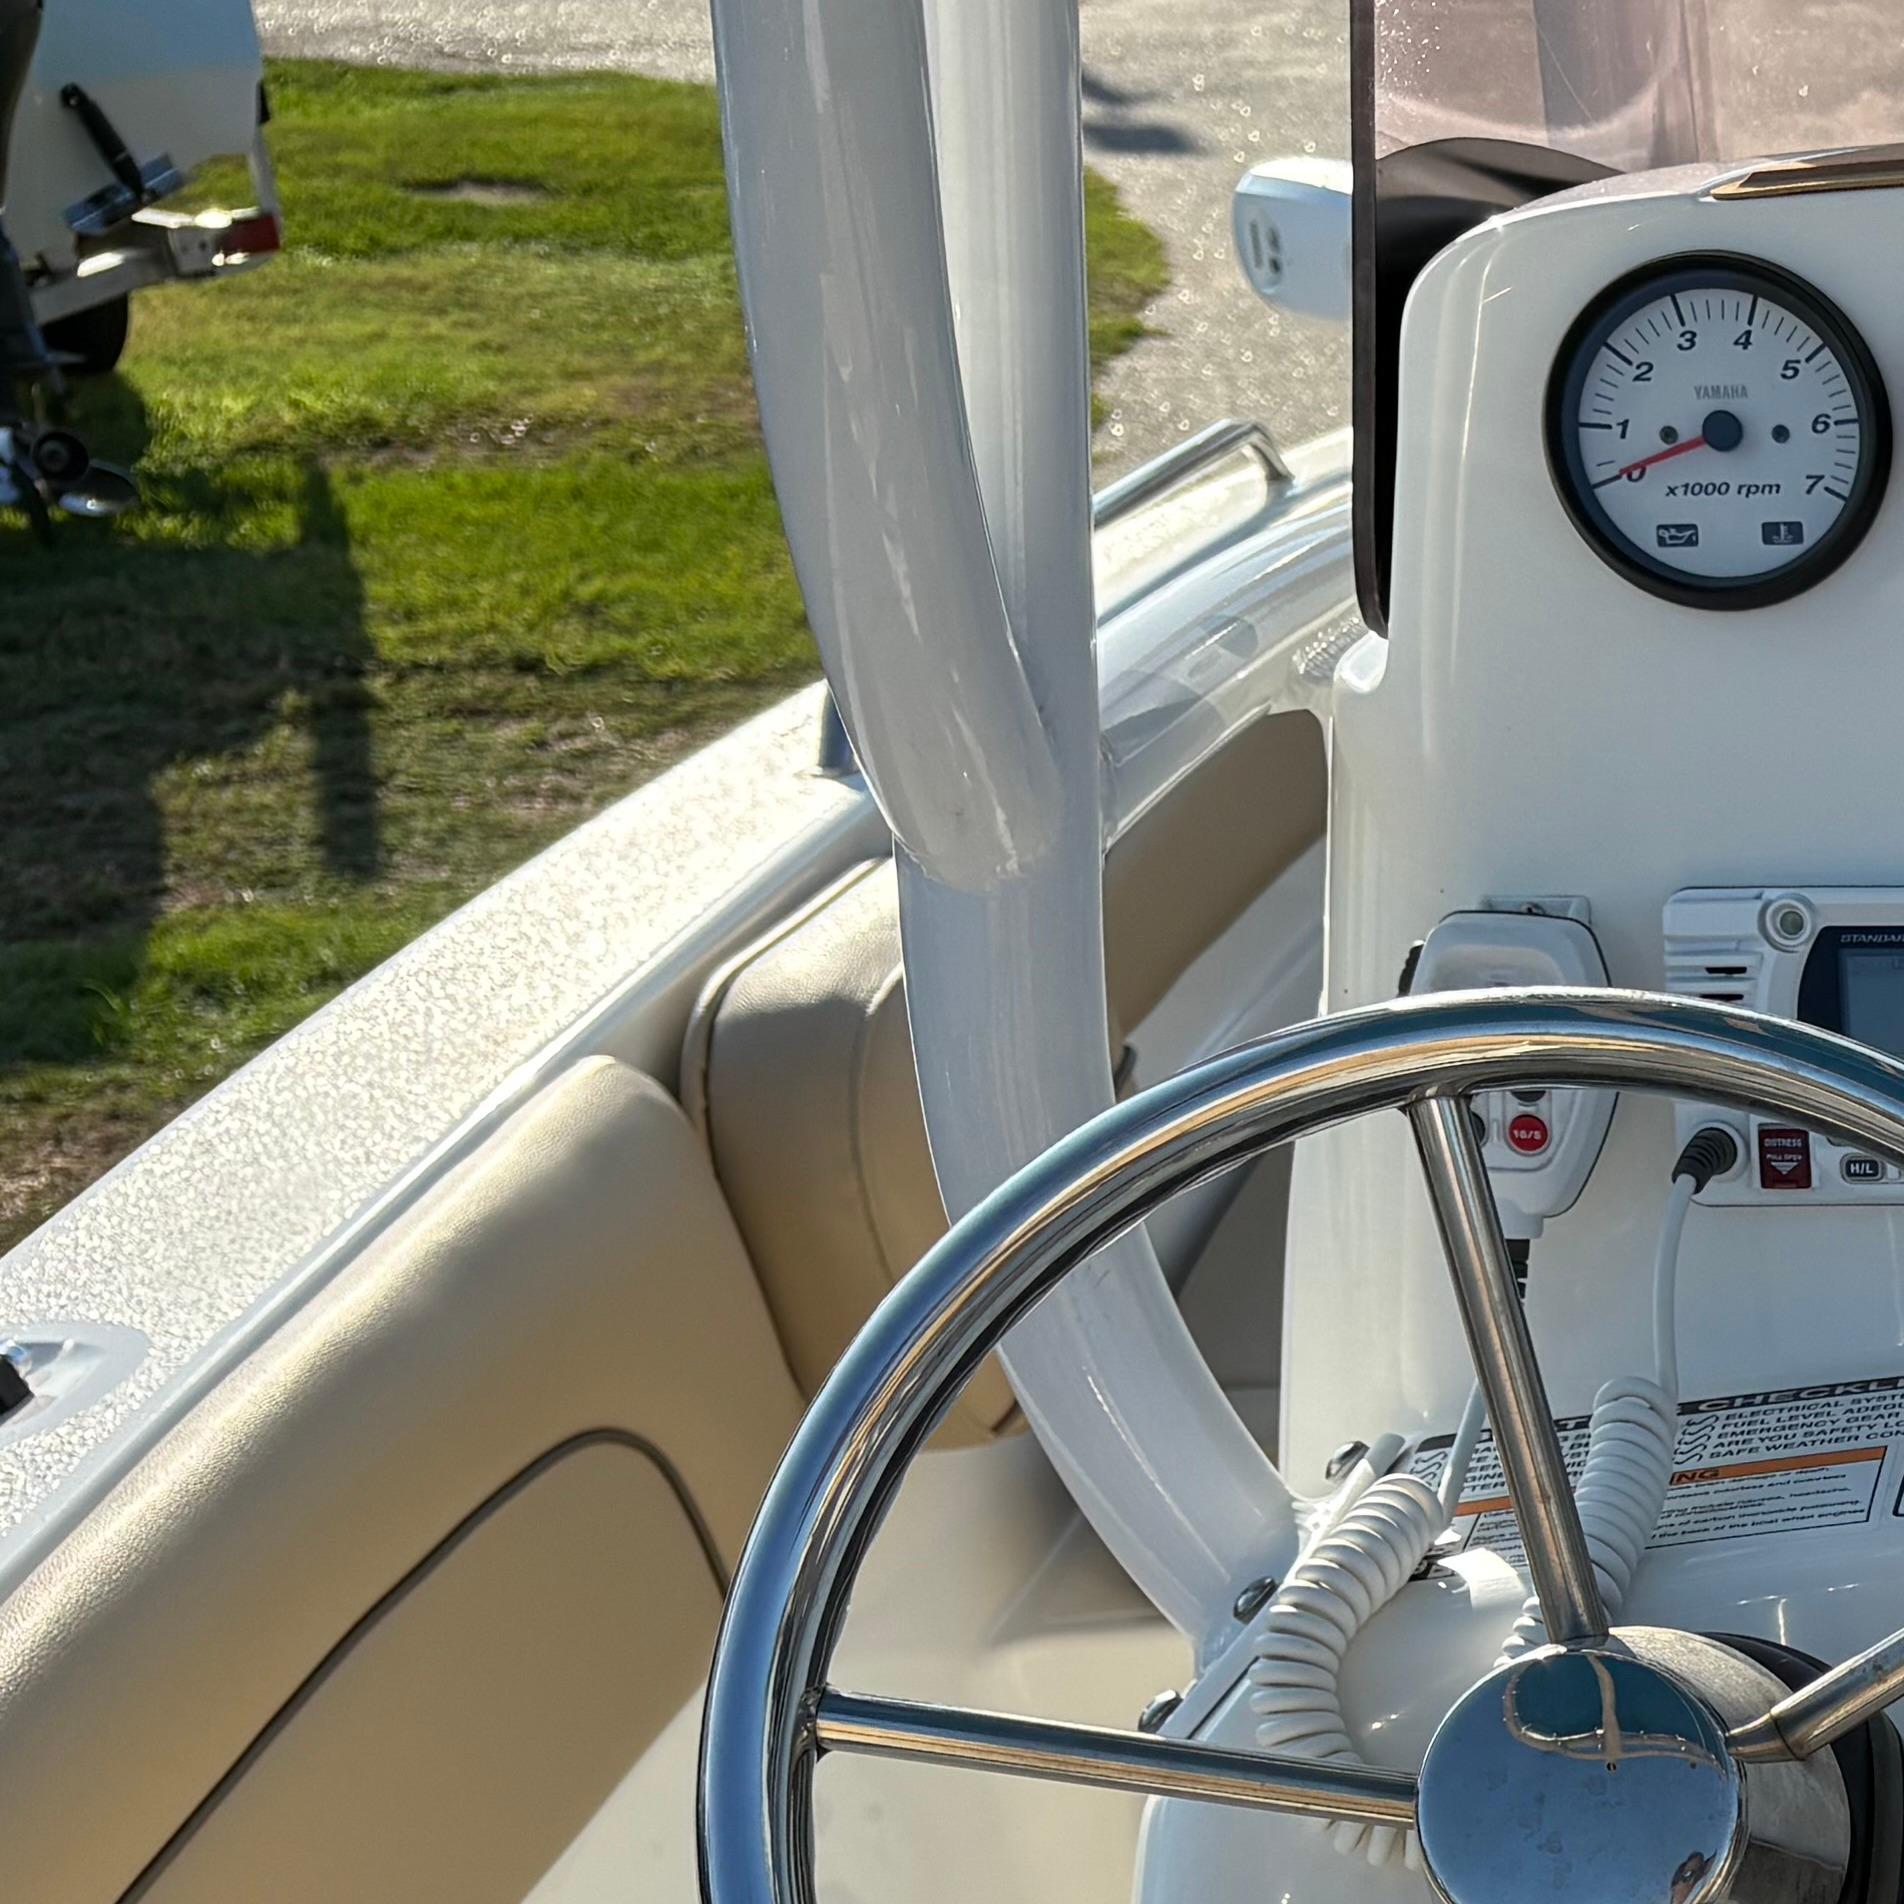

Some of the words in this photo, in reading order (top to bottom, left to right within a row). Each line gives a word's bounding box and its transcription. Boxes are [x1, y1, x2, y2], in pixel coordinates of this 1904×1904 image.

[1677, 331, 1697, 351] 3
[1733, 330, 1753, 350] 4
[1632, 362, 1655, 382] 2
[1780, 360, 1801, 379] 5
[1694, 385, 1748, 400] YAMAHA
[1617, 419, 1630, 439] 1
[1811, 414, 1831, 434] 6
[1665, 482, 1730, 497] x1000
[1737, 483, 1781, 498] rpm
[1804, 474, 1825, 495] 7
[1850, 1162, 1874, 1174] H/L
[1722, 1418, 1770, 1430] FUEL
[1776, 1410, 1836, 1423] LEVEL
[1725, 1401, 1845, 1421] ELECTRICAL
[1718, 1418, 1840, 1439] EMERGENCY
[1846, 1412, 1900, 1424] GEAR
[1714, 1438, 1753, 1449] ARE
[1758, 1433, 1796, 1443] YOU
[1803, 1424, 1877, 1438] SAFETY
[1709, 1446, 1760, 1459] SAFE
[1766, 1435, 1859, 1451] WEATHER
